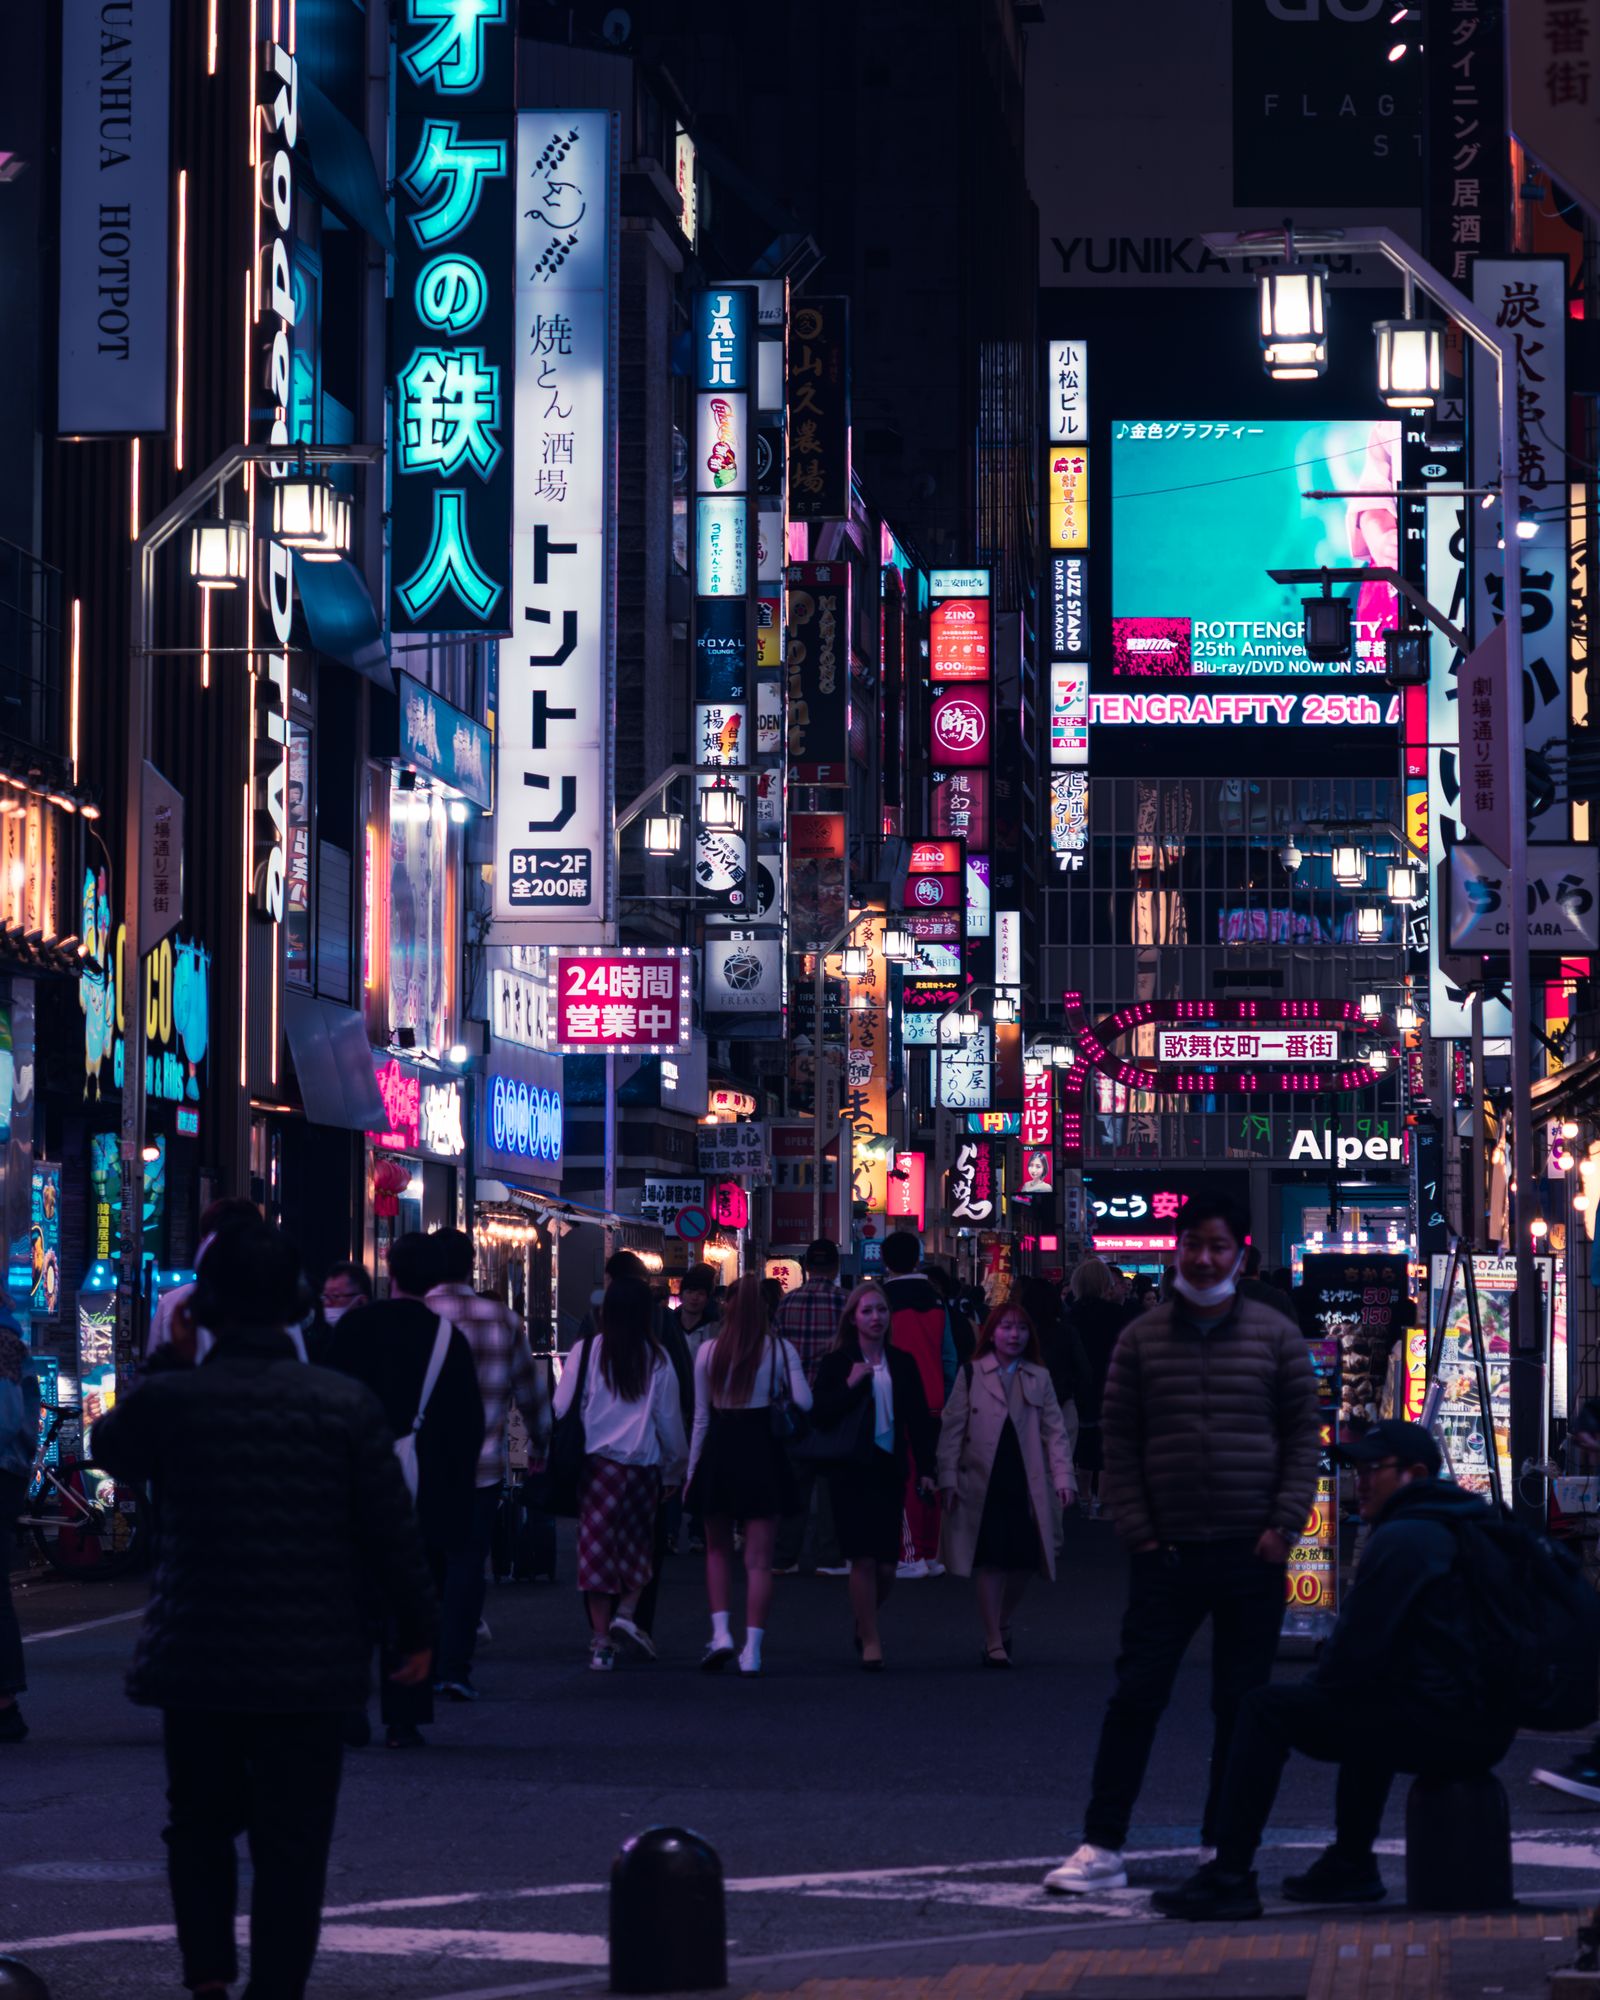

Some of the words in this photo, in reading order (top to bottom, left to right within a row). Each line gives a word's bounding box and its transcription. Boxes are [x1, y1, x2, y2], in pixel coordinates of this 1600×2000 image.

[1264, 94, 1422, 117] FLAG
[268, 44, 298, 478] Rodeo
[1051, 237, 1230, 274] YUNIKA
[97, 203, 129, 361] HOTPOT
[396, 0, 506, 623] オケの鉄人
[707, 295, 736, 384] JAビル
[1058, 346, 1079, 435] 小松ビル
[530, 313, 575, 502] 焼とん酒場
[1129, 423, 1264, 440] 金色グラフティー
[1055, 560, 1064, 589] DARTS
[1066, 559, 1082, 596] BUZZ
[944, 611, 975, 620] ZINO
[1066, 600, 1082, 651] STAND
[1055, 604, 1064, 651] KARAOKE
[1194, 621, 1380, 639] ROTTENGTY
[698, 639, 745, 648] ROYAL
[1194, 641, 1232, 657] 25th
[525, 524, 578, 832] トントン
[1194, 660, 1283, 675] Blu-ray/DVD
[1288, 660, 1325, 673] NOW
[1329, 661, 1351, 673] ON
[1355, 660, 1387, 674] SAL
[731, 686, 743, 697] 2F
[932, 687, 944, 696] 4F
[1301, 693, 1381, 725] 25th
[265, 538, 292, 924] Drive
[1058, 738, 1080, 748] ATM
[1472, 677, 1495, 813] 劇場通り一番街
[933, 771, 946, 782] 3F
[1409, 763, 1421, 774] 2F
[913, 852, 945, 861] ZINO
[972, 860, 989, 874] 2F
[1055, 851, 1084, 871] 7F
[511, 878, 588, 898] 全200席
[730, 930, 755, 941] B1
[1496, 922, 1563, 937] CHKARA
[116, 922, 172, 1045] CCO
[565, 965, 674, 1000] 24時間
[502, 979, 548, 1039] やきとん
[720, 995, 767, 1006] FREAKS
[565, 1003, 673, 1039] 営業中
[1164, 1035, 1334, 1059] 歌舞伎町一番街
[699, 1126, 761, 1148] 酒場心
[699, 1150, 762, 1169] 新宿本店
[1362, 1287, 1391, 1305] 50
[1360, 1306, 1392, 1325] 150
